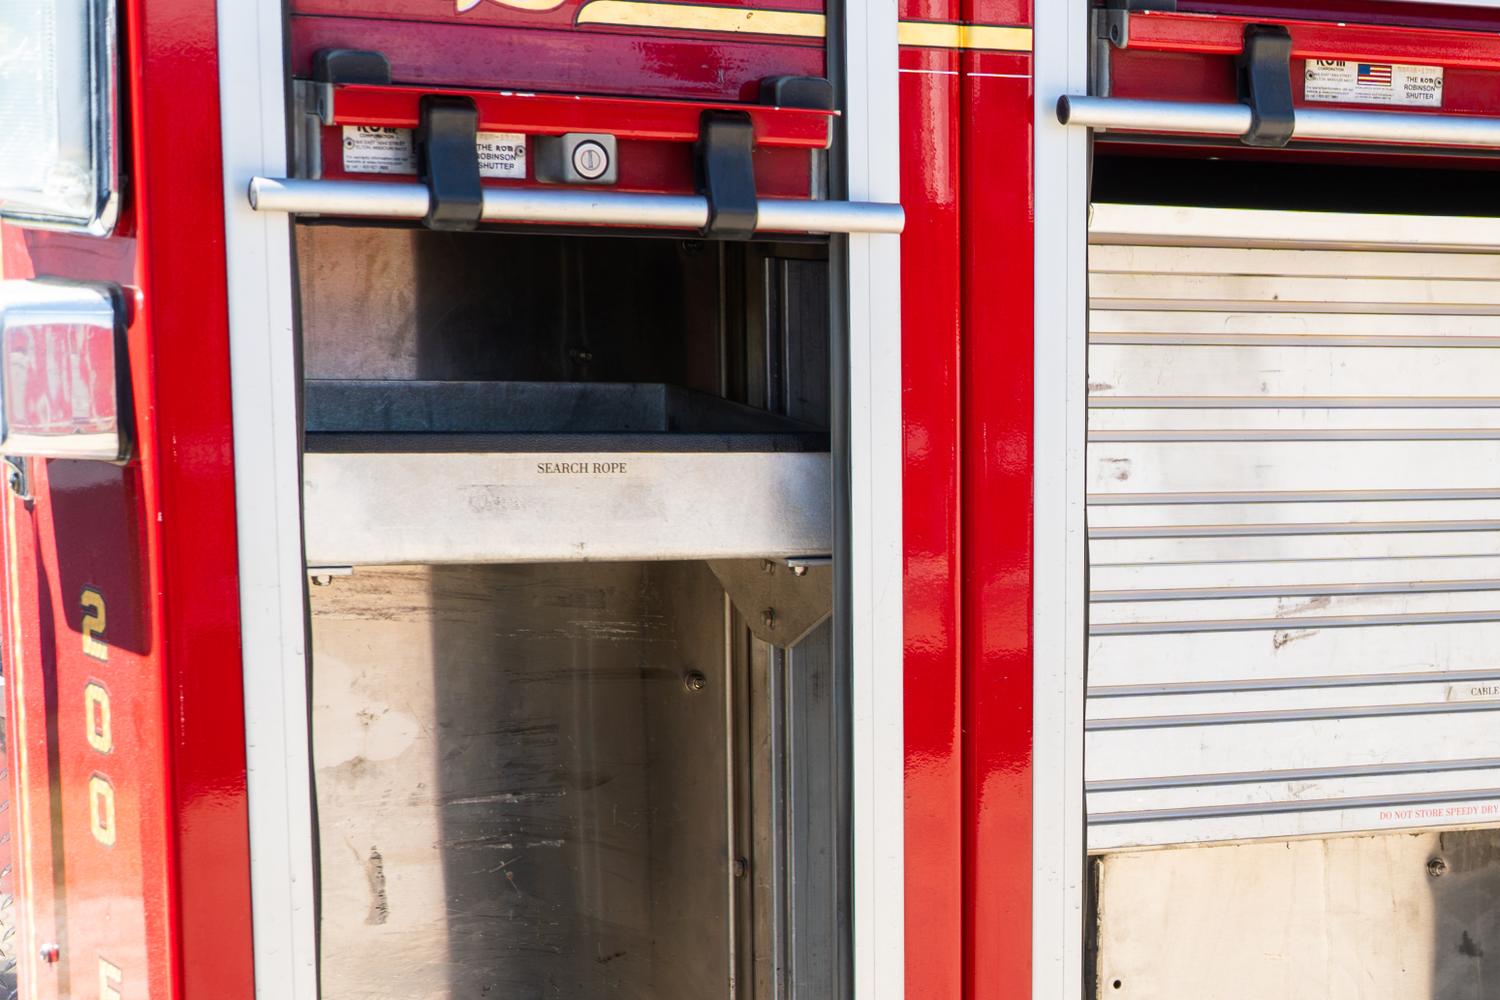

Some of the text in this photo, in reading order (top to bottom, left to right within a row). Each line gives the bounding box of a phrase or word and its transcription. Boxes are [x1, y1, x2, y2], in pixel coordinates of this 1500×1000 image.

[1404, 84, 1436, 92] ROBINSON
[1405, 92, 1434, 100] SHUTTER
[477, 143, 493, 152] THE
[477, 152, 516, 162] OBINSON
[479, 162, 515, 170] SHUTTER
[537, 462, 628, 475] SEARCH ROPE
[1471, 686, 1499, 696] CABLE
[80, 585, 117, 850] 200
[1379, 811, 1392, 821] DO
[1394, 810, 1413, 821] NOT
[1415, 808, 1444, 820] STORE
[1445, 806, 1478, 817] SPEEDY
[1481, 804, 1499, 815] DRY
